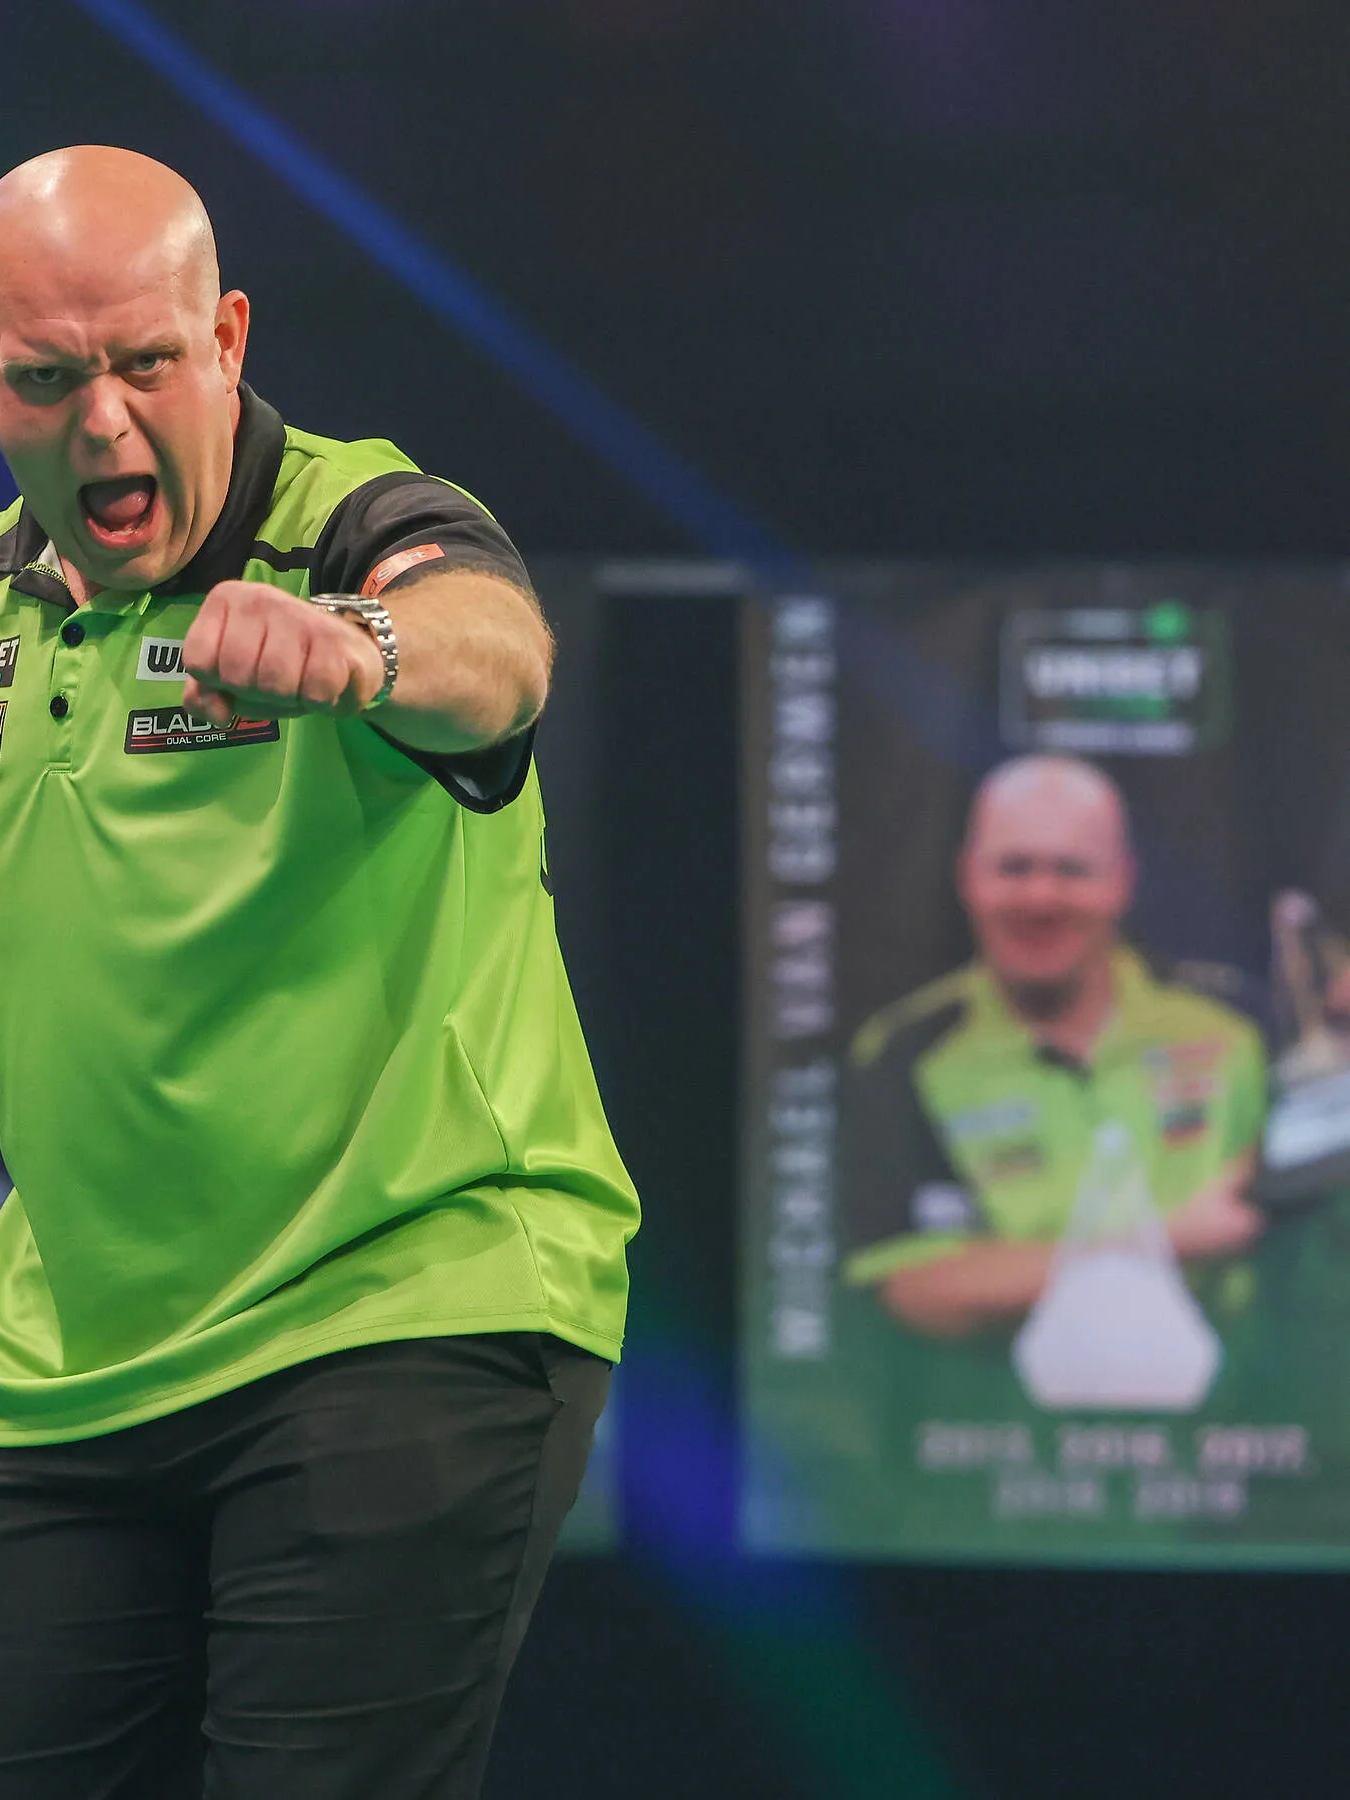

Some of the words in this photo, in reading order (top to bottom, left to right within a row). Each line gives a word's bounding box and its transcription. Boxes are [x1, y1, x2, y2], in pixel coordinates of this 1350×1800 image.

[132, 713, 235, 737] BLAD
[166, 736, 192, 746] DUAL
[195, 732, 228, 744] CORE
